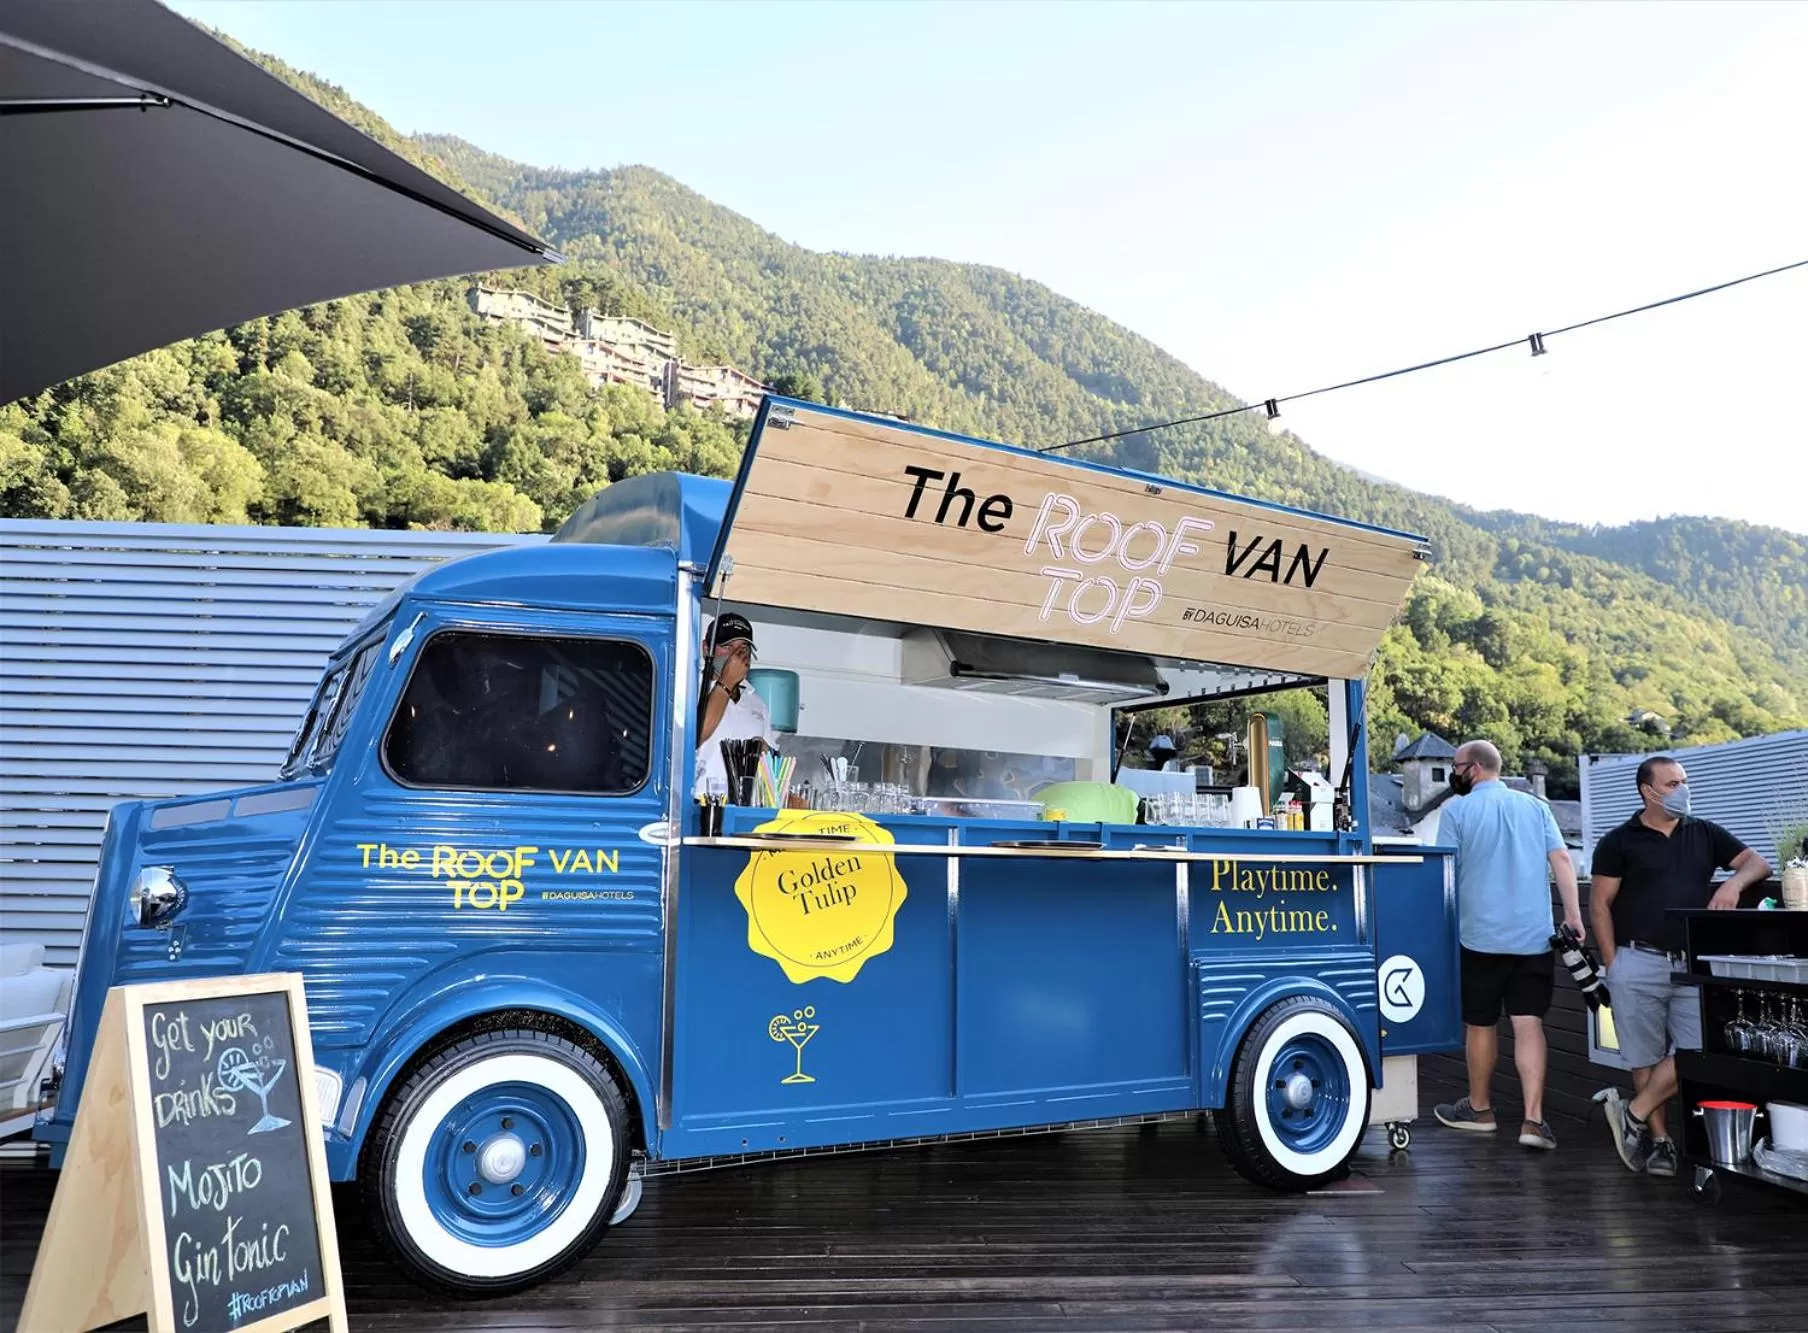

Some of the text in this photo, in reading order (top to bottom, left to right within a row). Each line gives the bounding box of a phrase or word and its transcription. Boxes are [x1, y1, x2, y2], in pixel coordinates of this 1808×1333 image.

[904, 466, 1329, 588] The ROOF VAN
[1039, 567, 1162, 634] TOP
[357, 844, 618, 879] The ROOF VAN
[777, 857, 862, 895] Golden
[1210, 860, 1338, 899] Playtime.
[446, 880, 525, 912] TOP
[792, 881, 857, 915] Tulip
[1210, 900, 1338, 941] Anytime.
[815, 935, 864, 960] ANYTIME
[152, 1011, 195, 1080] Get
[174, 1231, 221, 1327] Gin
